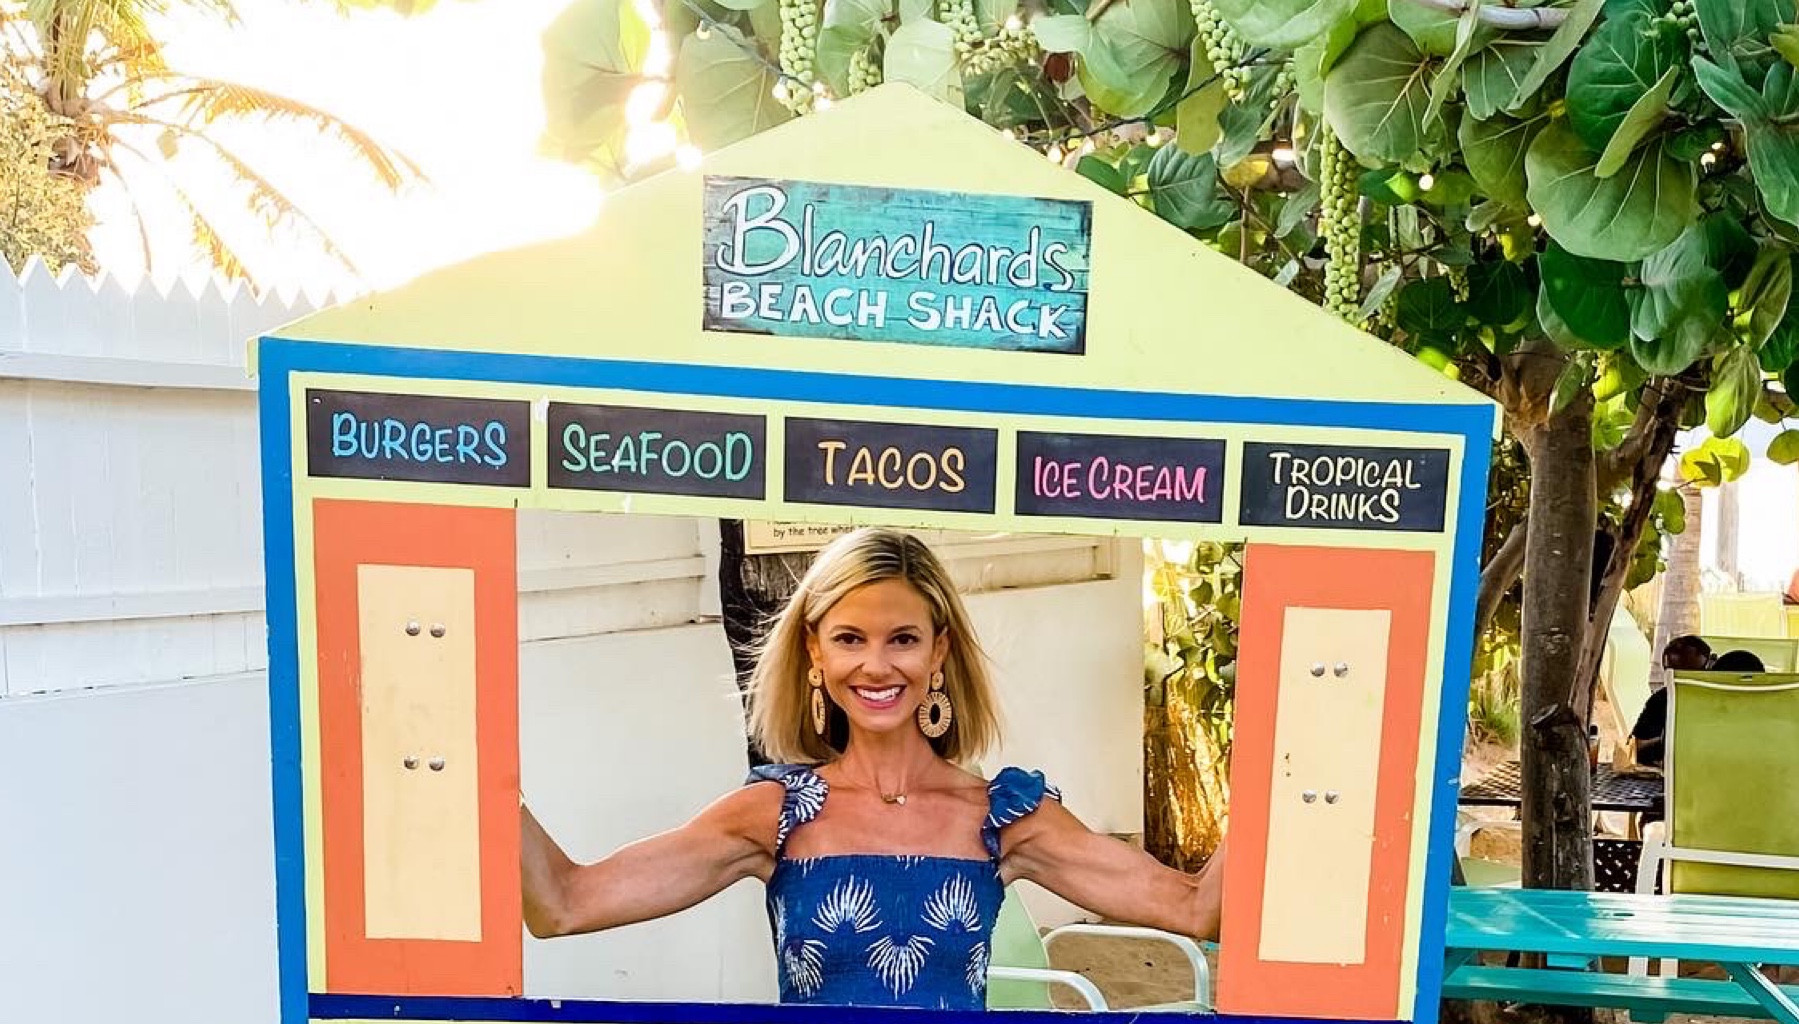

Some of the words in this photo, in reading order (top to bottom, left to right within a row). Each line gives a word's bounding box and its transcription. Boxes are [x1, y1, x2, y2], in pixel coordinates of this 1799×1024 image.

[715, 184, 1075, 292] Blanchards
[721, 281, 887, 328] BEACH
[907, 290, 1069, 339] SHACK
[331, 411, 507, 467] BURGERS
[562, 423, 753, 482] SEAFOOD
[818, 441, 966, 493] TACOS
[1033, 456, 1082, 497] ICE
[1087, 456, 1207, 504] CREAM
[1269, 452, 1421, 489] TROPICAL
[1285, 485, 1401, 523] DRINKS
[773, 527, 786, 539] by
[788, 526, 805, 536] the
[808, 526, 828, 535] tree
